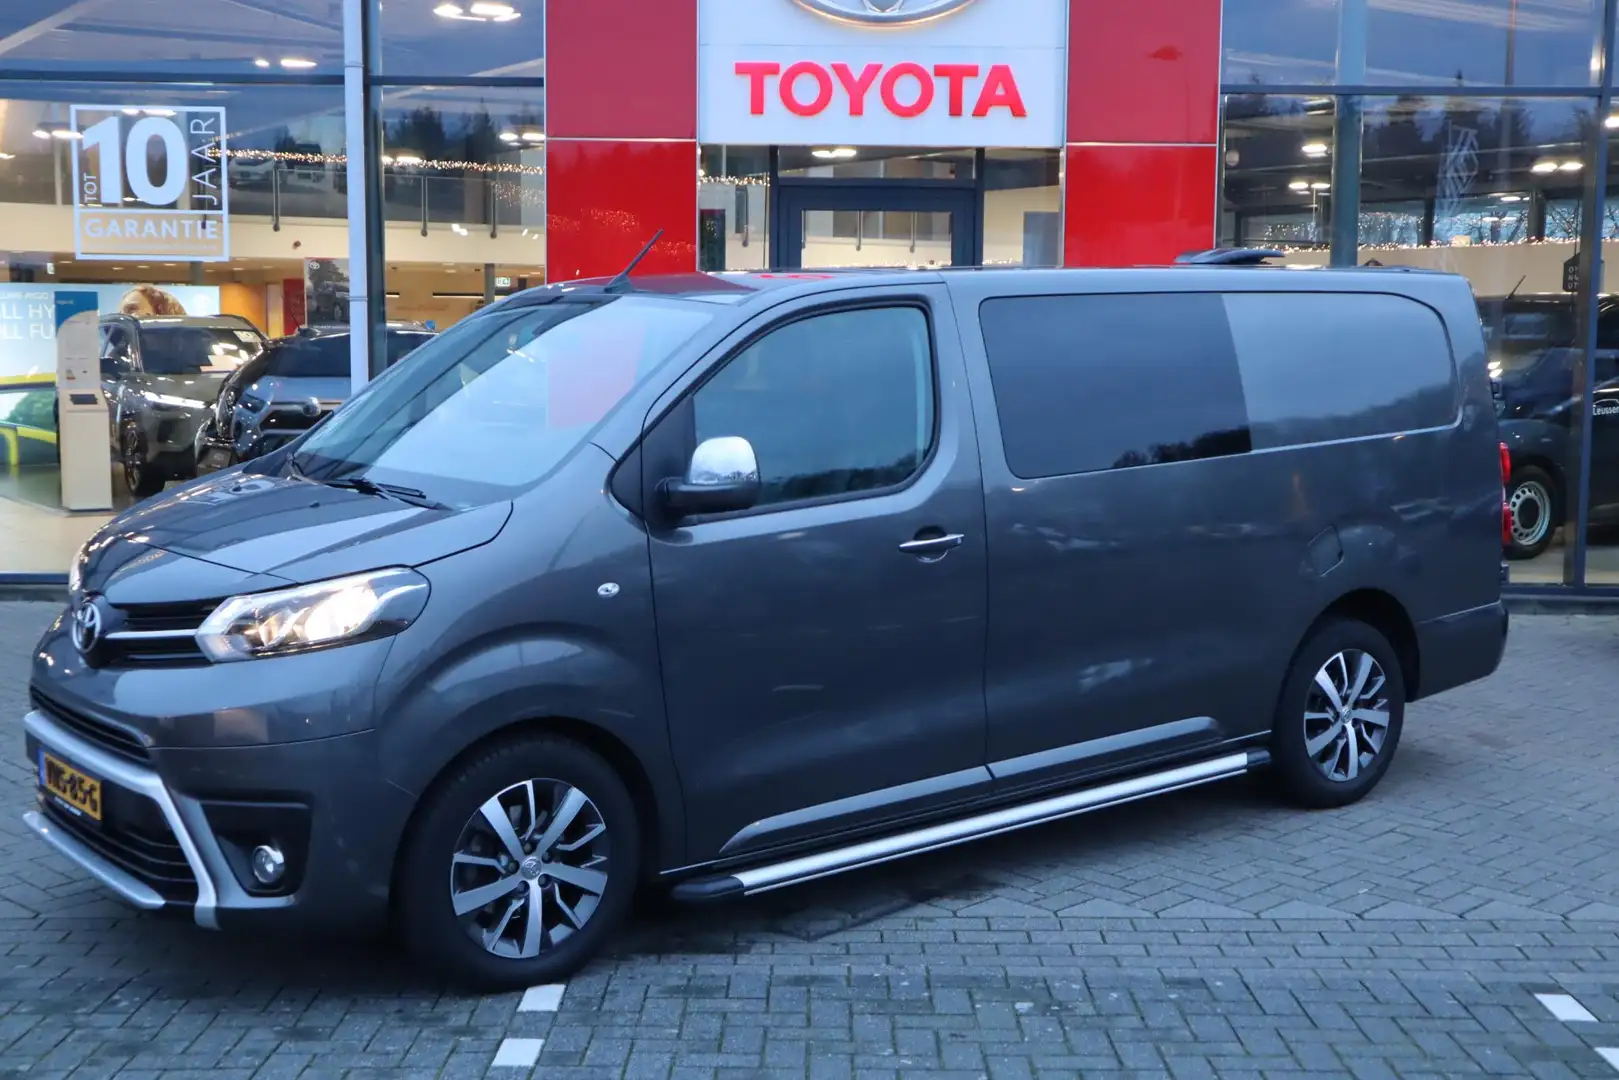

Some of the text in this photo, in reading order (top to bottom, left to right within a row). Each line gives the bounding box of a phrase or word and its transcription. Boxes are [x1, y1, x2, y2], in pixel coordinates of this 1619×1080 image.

[734, 61, 1027, 118] TOYOTA
[82, 116, 188, 206] 10
[83, 172, 98, 203] TOT
[190, 117, 218, 206] JAAR
[84, 217, 218, 240] GARANTIE
